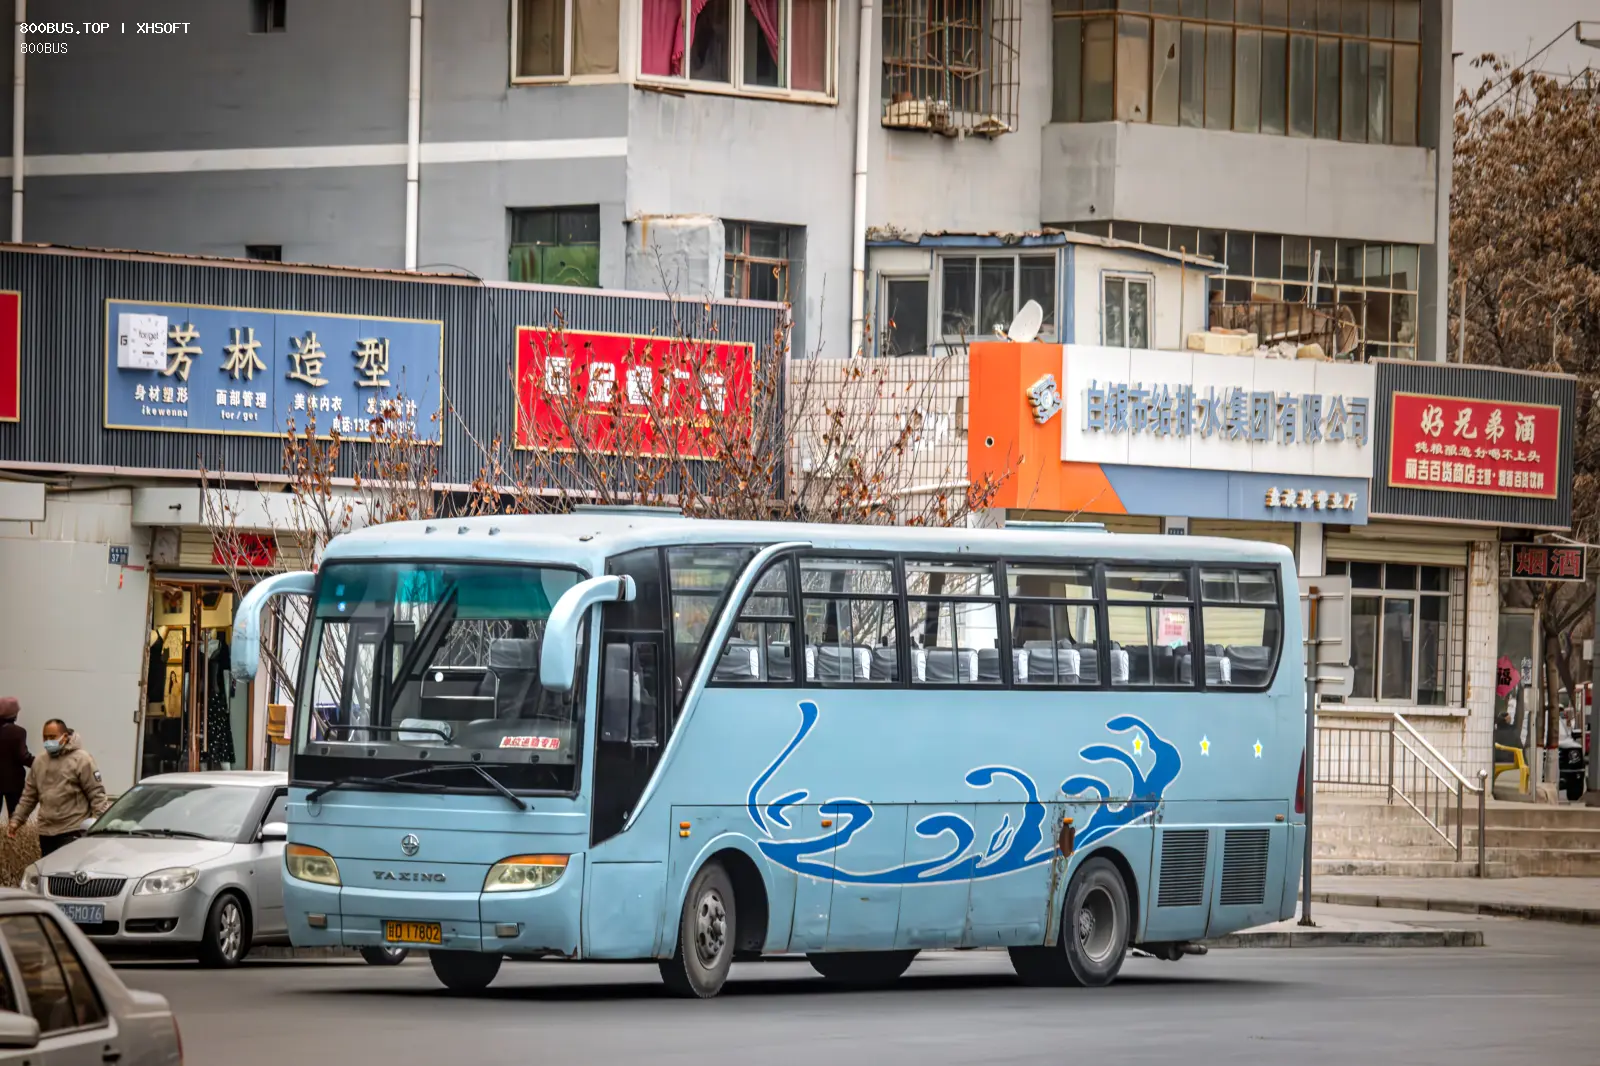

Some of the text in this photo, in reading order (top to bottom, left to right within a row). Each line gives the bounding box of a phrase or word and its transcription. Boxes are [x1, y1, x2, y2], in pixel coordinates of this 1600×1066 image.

[160, 321, 391, 388] 芳林造型
[134, 383, 189, 403] 身材塑形
[215, 388, 267, 409] 面部管理
[294, 393, 342, 412] 美体内衣
[1420, 403, 1536, 445] 好兄弟酒
[1515, 547, 1581, 578] 烟酒
[373, 871, 447, 883] YAXING
